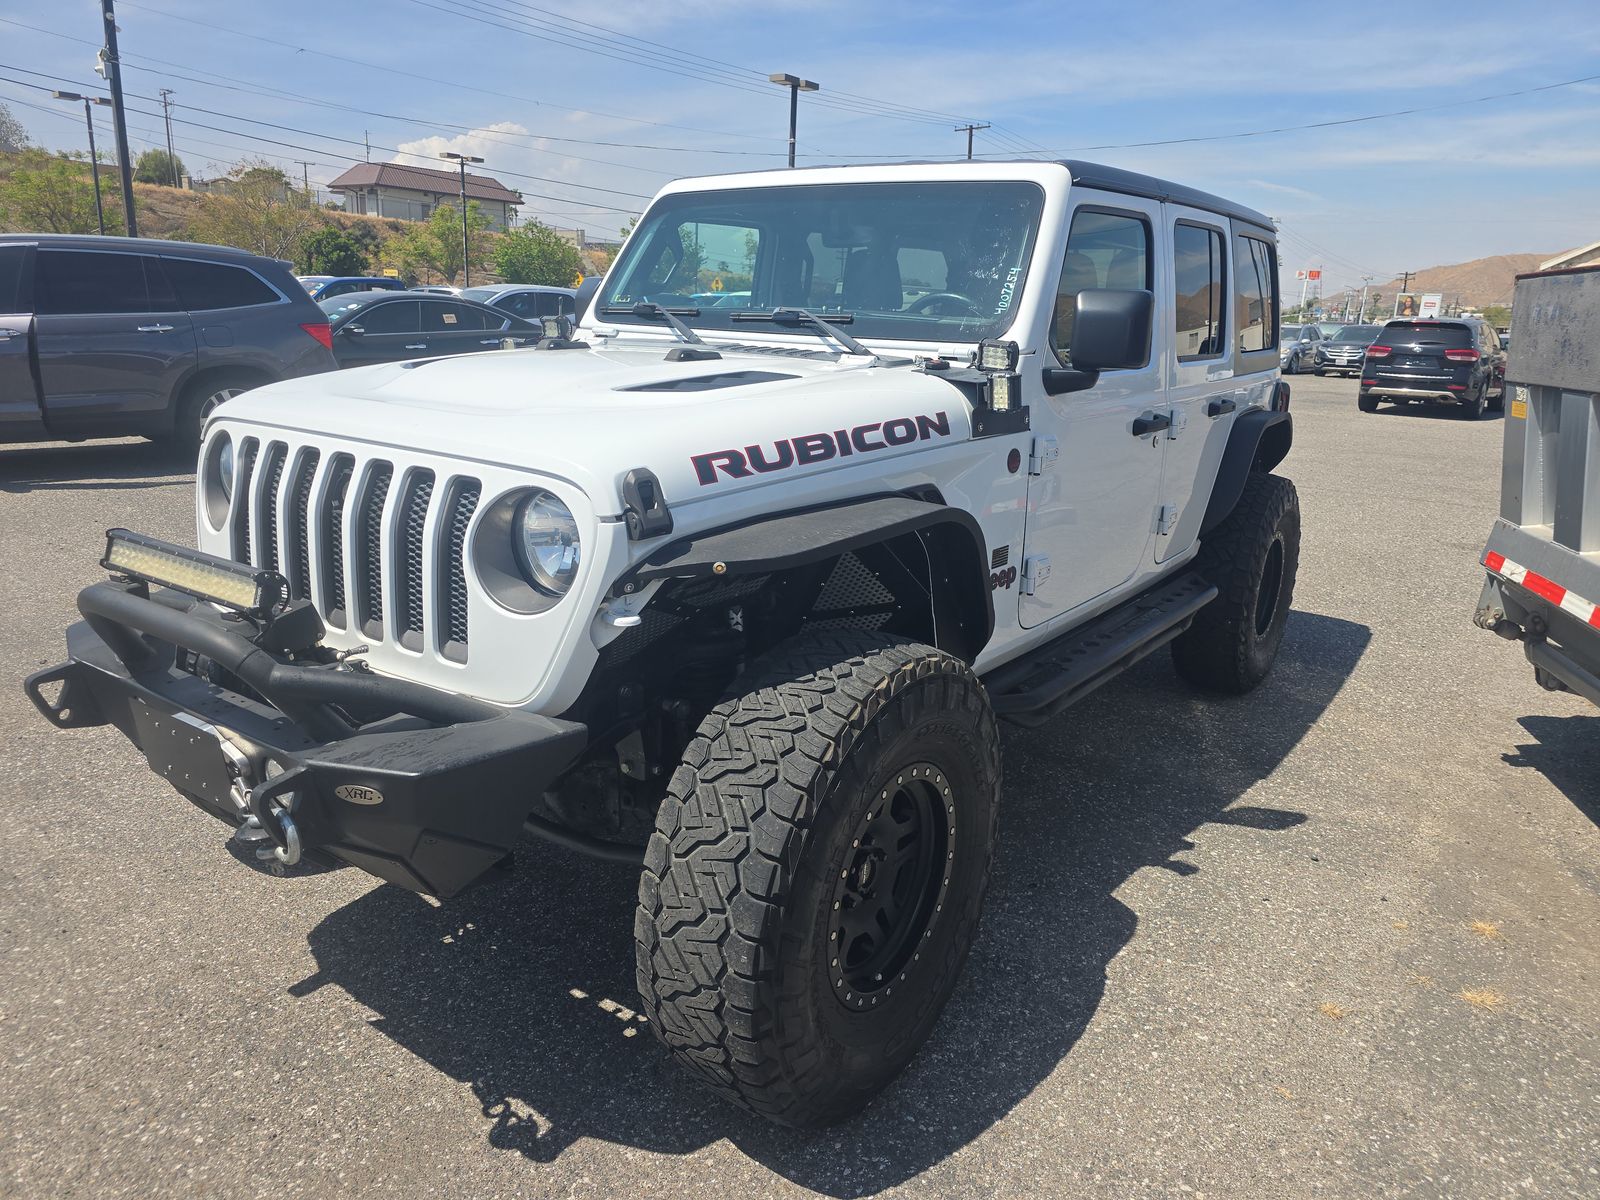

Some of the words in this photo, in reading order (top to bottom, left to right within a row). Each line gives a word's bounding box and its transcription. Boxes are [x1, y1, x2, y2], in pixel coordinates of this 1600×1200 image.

[994, 267, 1021, 315] 4007254
[690, 411, 950, 486] RUBICON
[990, 566, 1016, 590] eep
[345, 787, 373, 800] XRC
